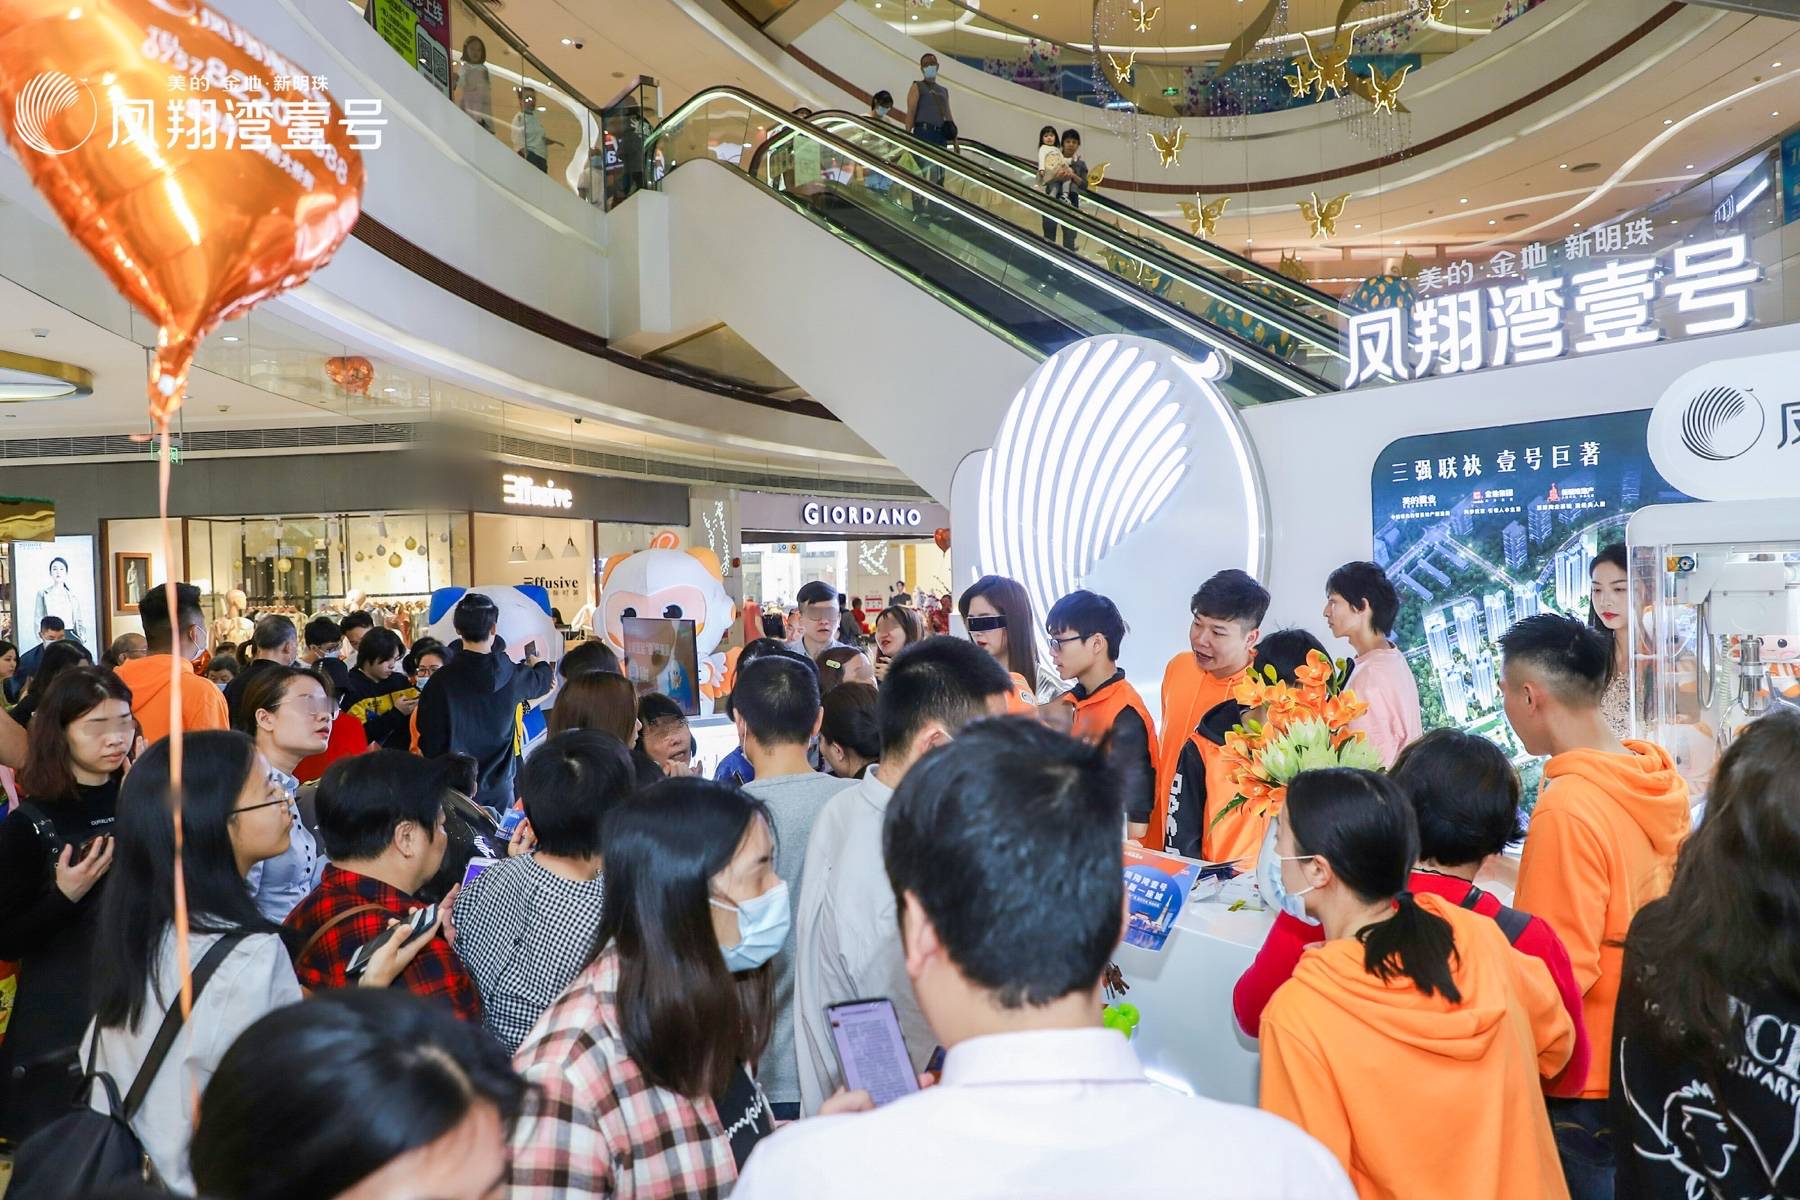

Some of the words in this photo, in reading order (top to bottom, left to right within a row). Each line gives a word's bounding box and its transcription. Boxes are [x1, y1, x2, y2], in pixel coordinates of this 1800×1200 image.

[1417, 216, 1655, 294] 美的·金地·新明珠
[1345, 233, 1761, 390] 凤翔湾壹号
[1391, 453, 1483, 483] 三强联袂
[1496, 441, 1601, 473] 壹号巨著
[803, 502, 922, 526] GIORDANO
